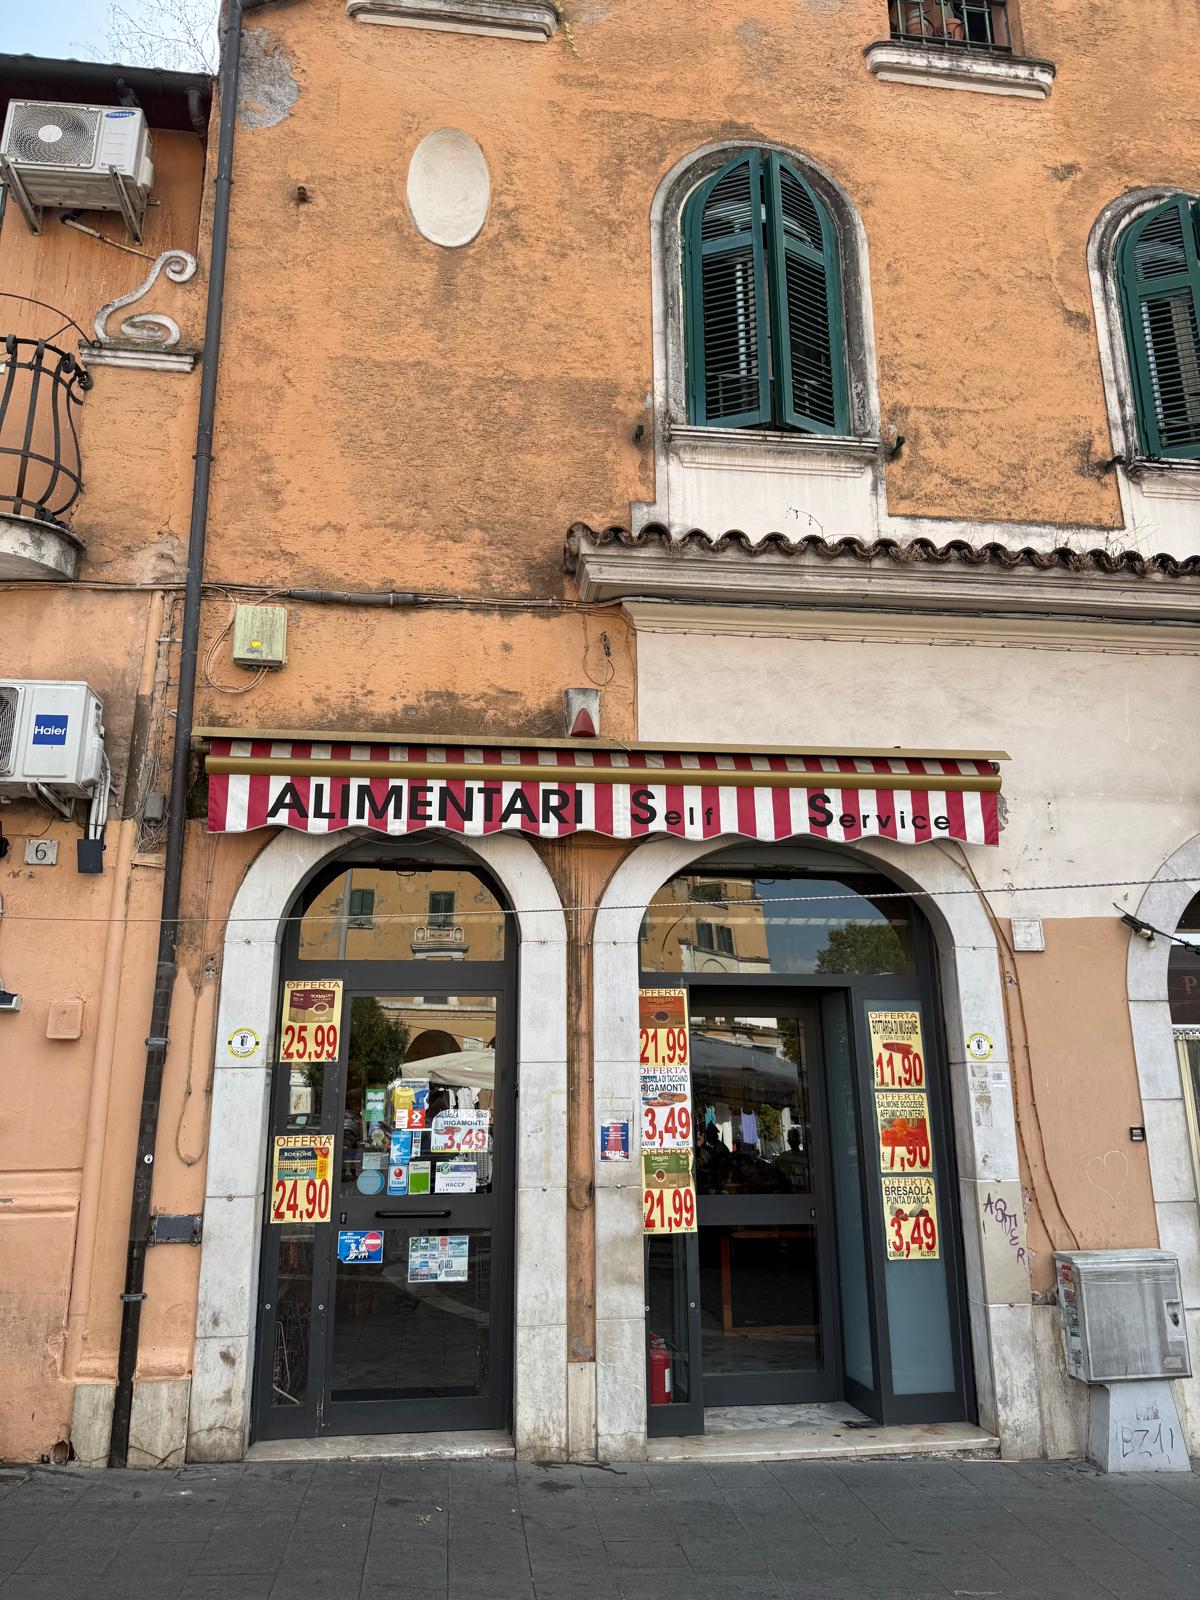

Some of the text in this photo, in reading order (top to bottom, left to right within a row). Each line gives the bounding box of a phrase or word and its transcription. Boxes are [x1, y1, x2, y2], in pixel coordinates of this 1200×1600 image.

[34, 726, 66, 735] Haier
[266, 782, 584, 824] ALIMENTARI
[631, 789, 951, 830] Self Service
[35, 842, 47, 860] 6
[287, 981, 341, 989] OFFERTA
[284, 1024, 337, 1061] 25,99
[639, 1027, 687, 1065] 21,99
[876, 1052, 923, 1088] 11,90
[641, 1084, 686, 1092] RIGAMONTI
[877, 1093, 924, 1101] OFFERTA
[900, 1101, 924, 1109] SCOZZESE
[644, 1107, 690, 1147] 3,49
[276, 1136, 332, 1147] OFFERTA
[443, 1128, 486, 1151] 3,49
[883, 1178, 932, 1186] OFFERTA
[885, 1186, 933, 1196] BRESAOLA
[274, 1179, 329, 1221] 24,90
[644, 1188, 695, 1232] 21,99
[887, 1196, 906, 1205] PUNTA
[890, 1216, 936, 1258] 3,49
